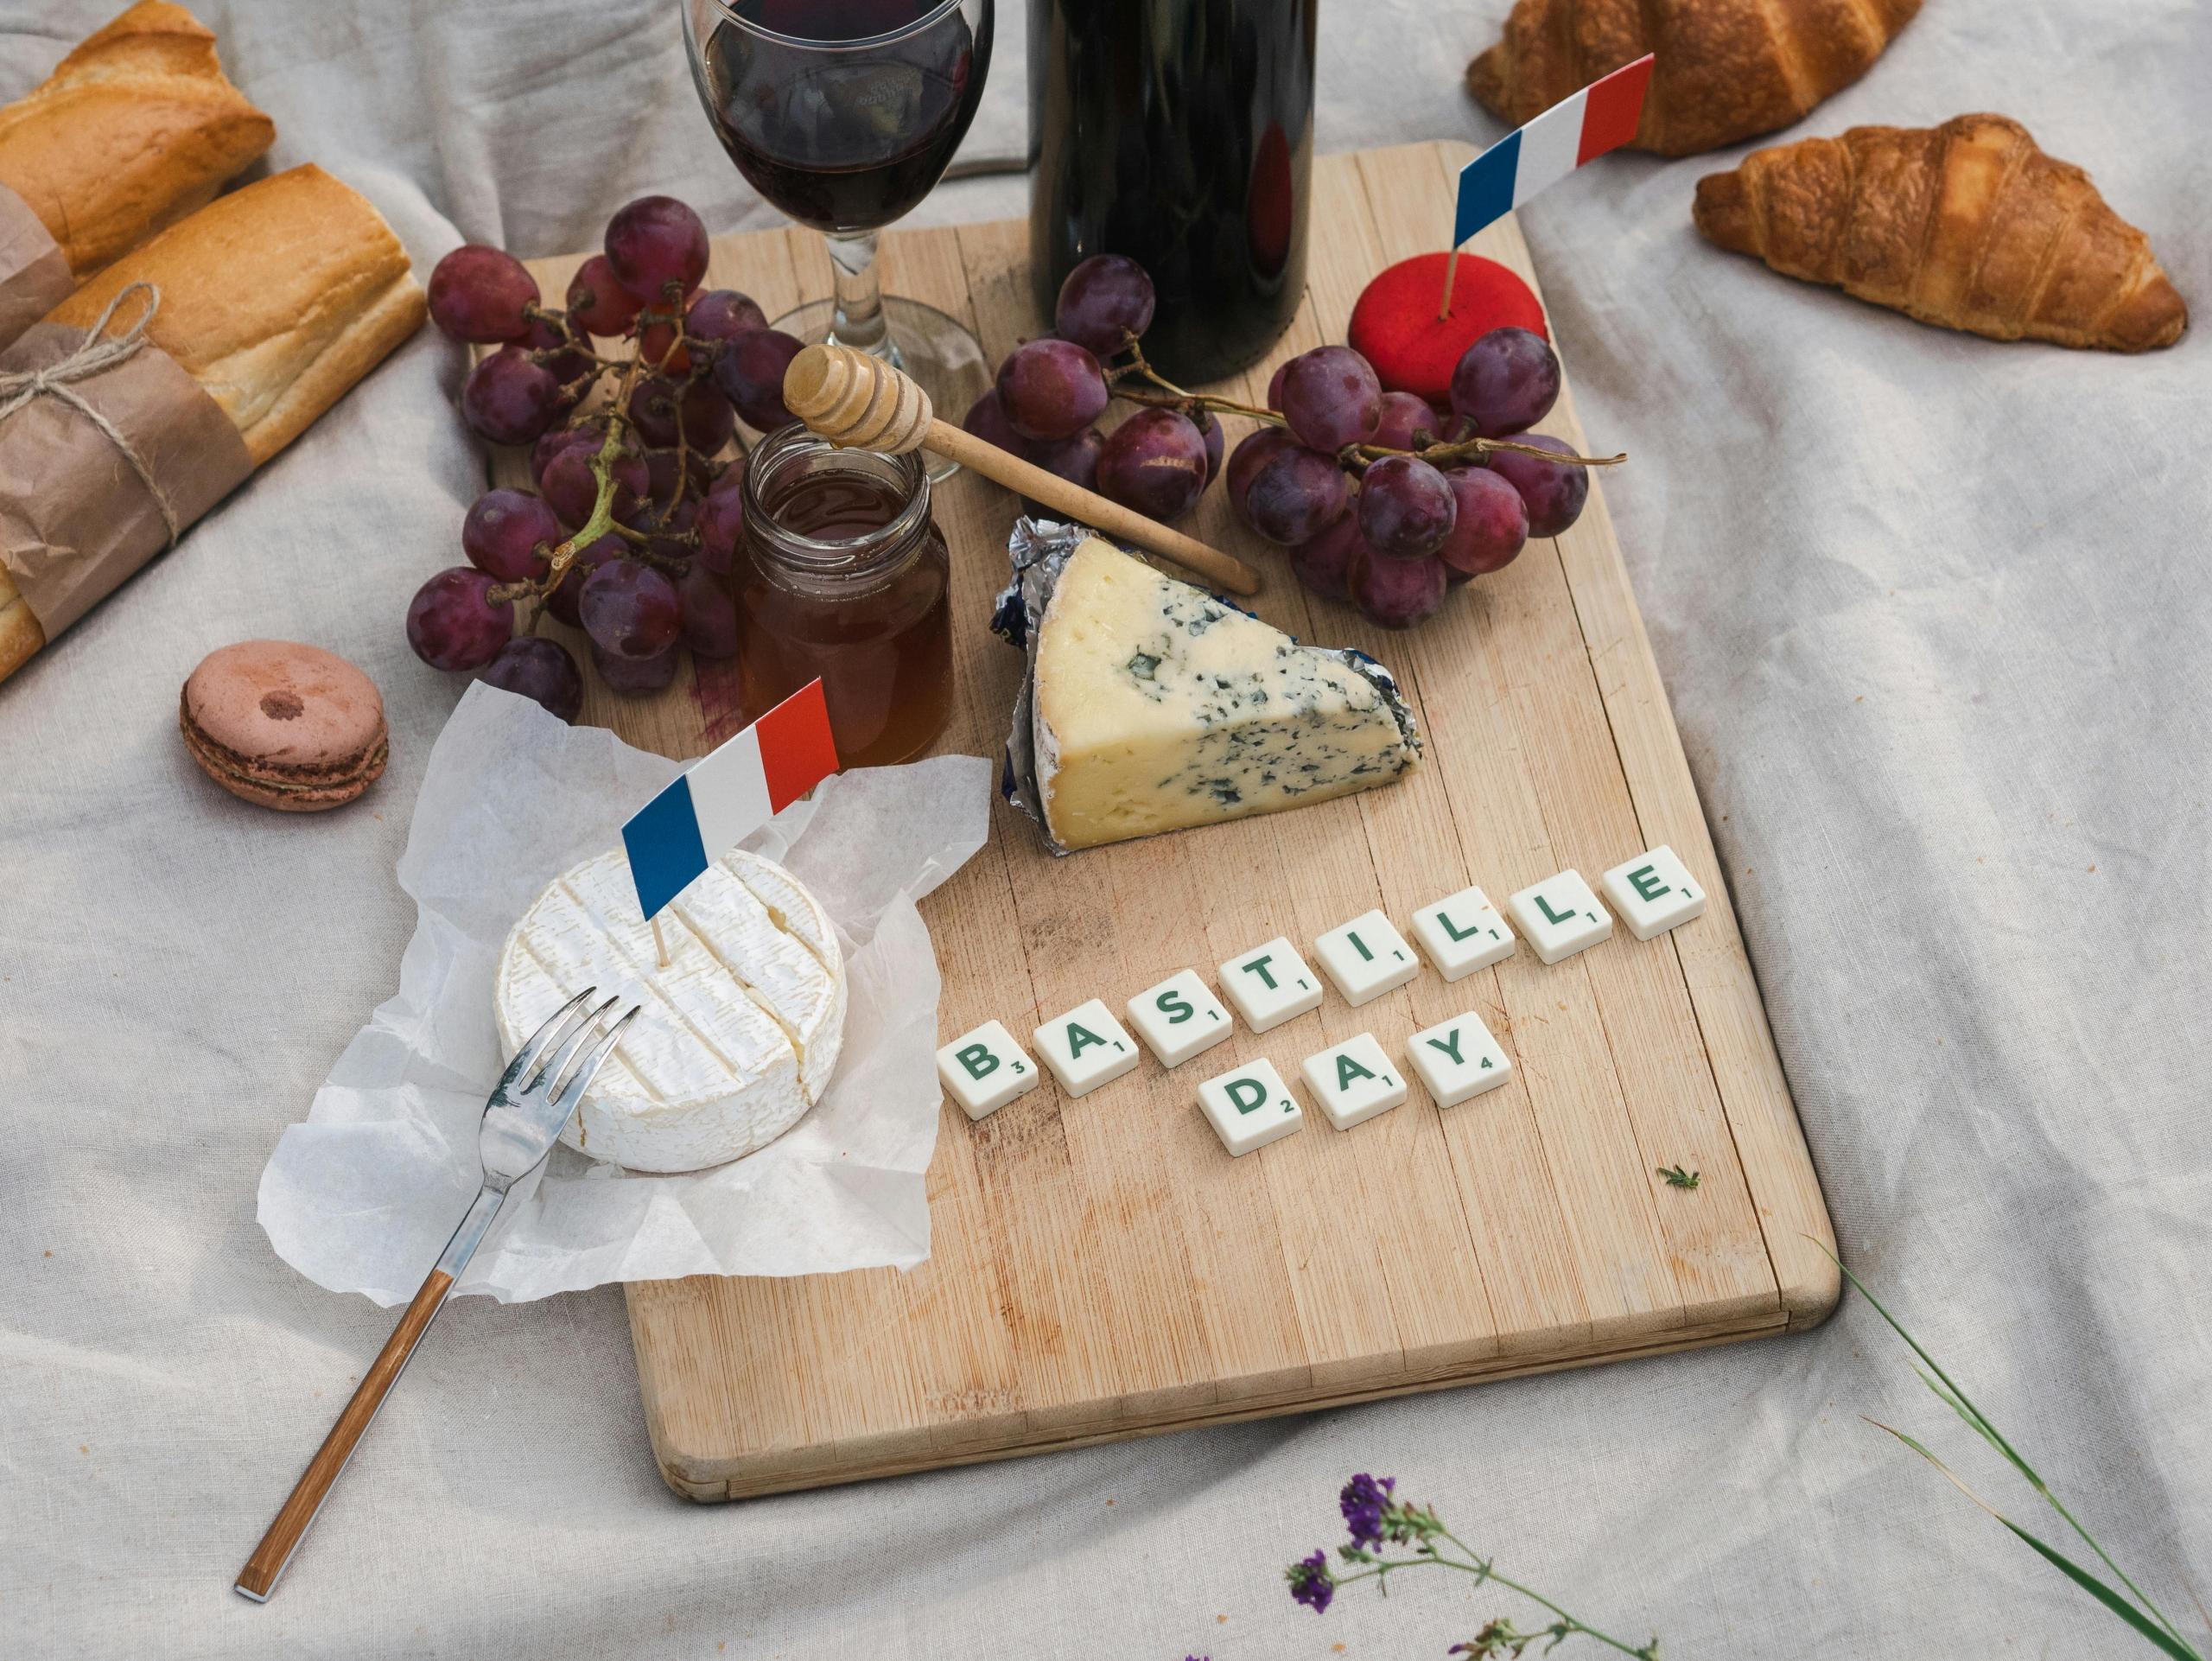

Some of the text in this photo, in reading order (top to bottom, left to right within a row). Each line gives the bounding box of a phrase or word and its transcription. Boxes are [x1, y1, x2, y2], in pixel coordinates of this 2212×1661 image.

[1681, 888, 1693, 899] 1
[1586, 912, 1598, 923] 1
[1488, 928, 1500, 940] 1
[1392, 950, 1405, 962] 1
[955, 865, 1671, 1080] BASTILLE
[1296, 978, 1309, 990] 1
[1207, 1009, 1220, 1021] 1
[1112, 1041, 1125, 1053] 1
[1010, 1060, 1026, 1074] 3
[1480, 1056, 1493, 1069] 4
[1224, 1029, 1465, 1115] DAY
[1382, 1075, 1394, 1087] 1
[1280, 1099, 1295, 1113] 2
